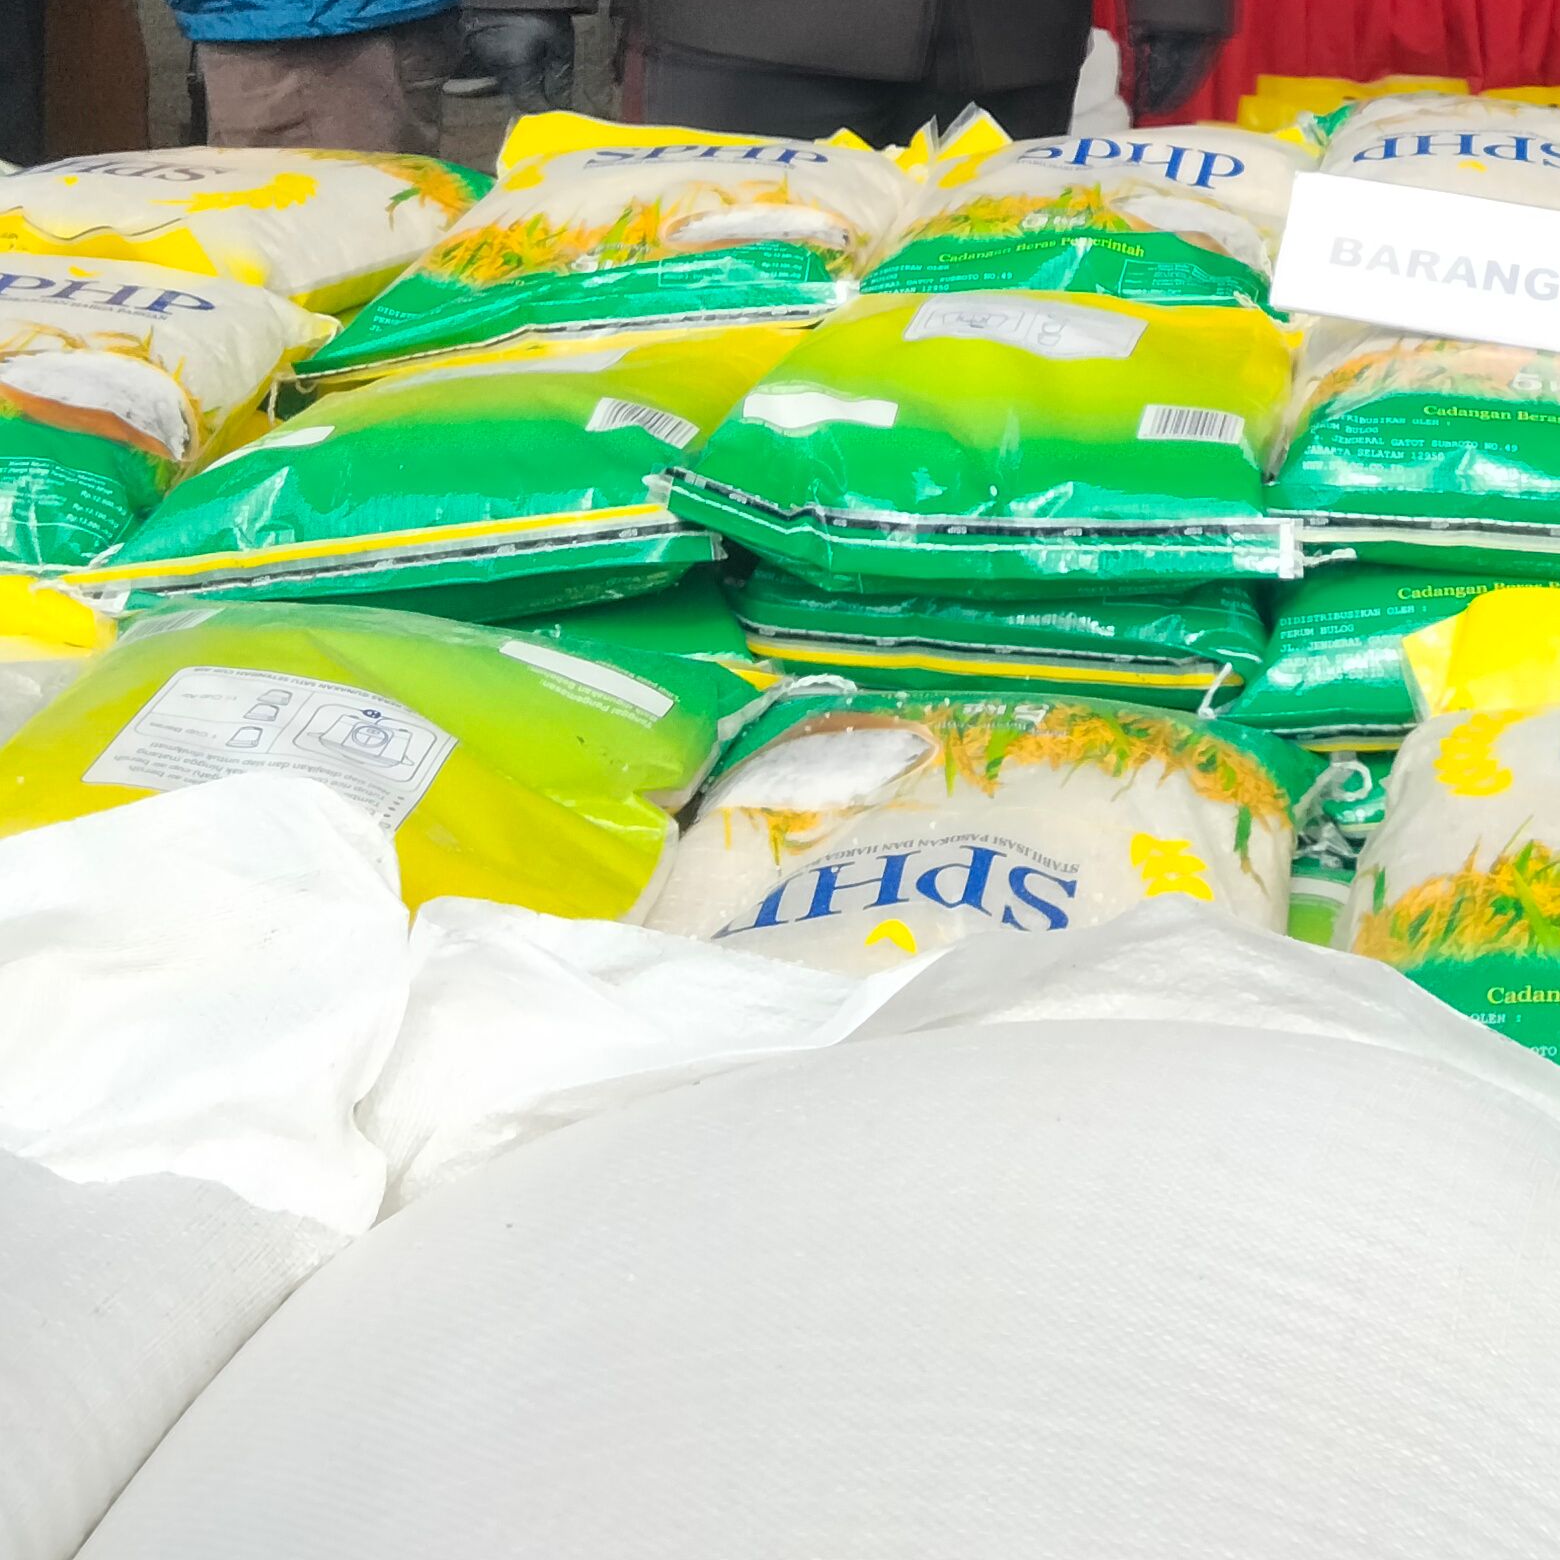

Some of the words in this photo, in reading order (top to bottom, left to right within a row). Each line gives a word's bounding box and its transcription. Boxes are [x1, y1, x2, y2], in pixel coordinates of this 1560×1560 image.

[1017, 136, 1246, 191] SPHP
[1328, 236, 1560, 303] BARANG
[1424, 404, 1511, 422] Cadangan
[1397, 583, 1489, 601] Cadangan
[1320, 624, 1355, 635] BULOG
[881, 839, 915, 854] DAN
[917, 832, 989, 848] PASOKAN
[1470, 1012, 1507, 1025] OLEH
